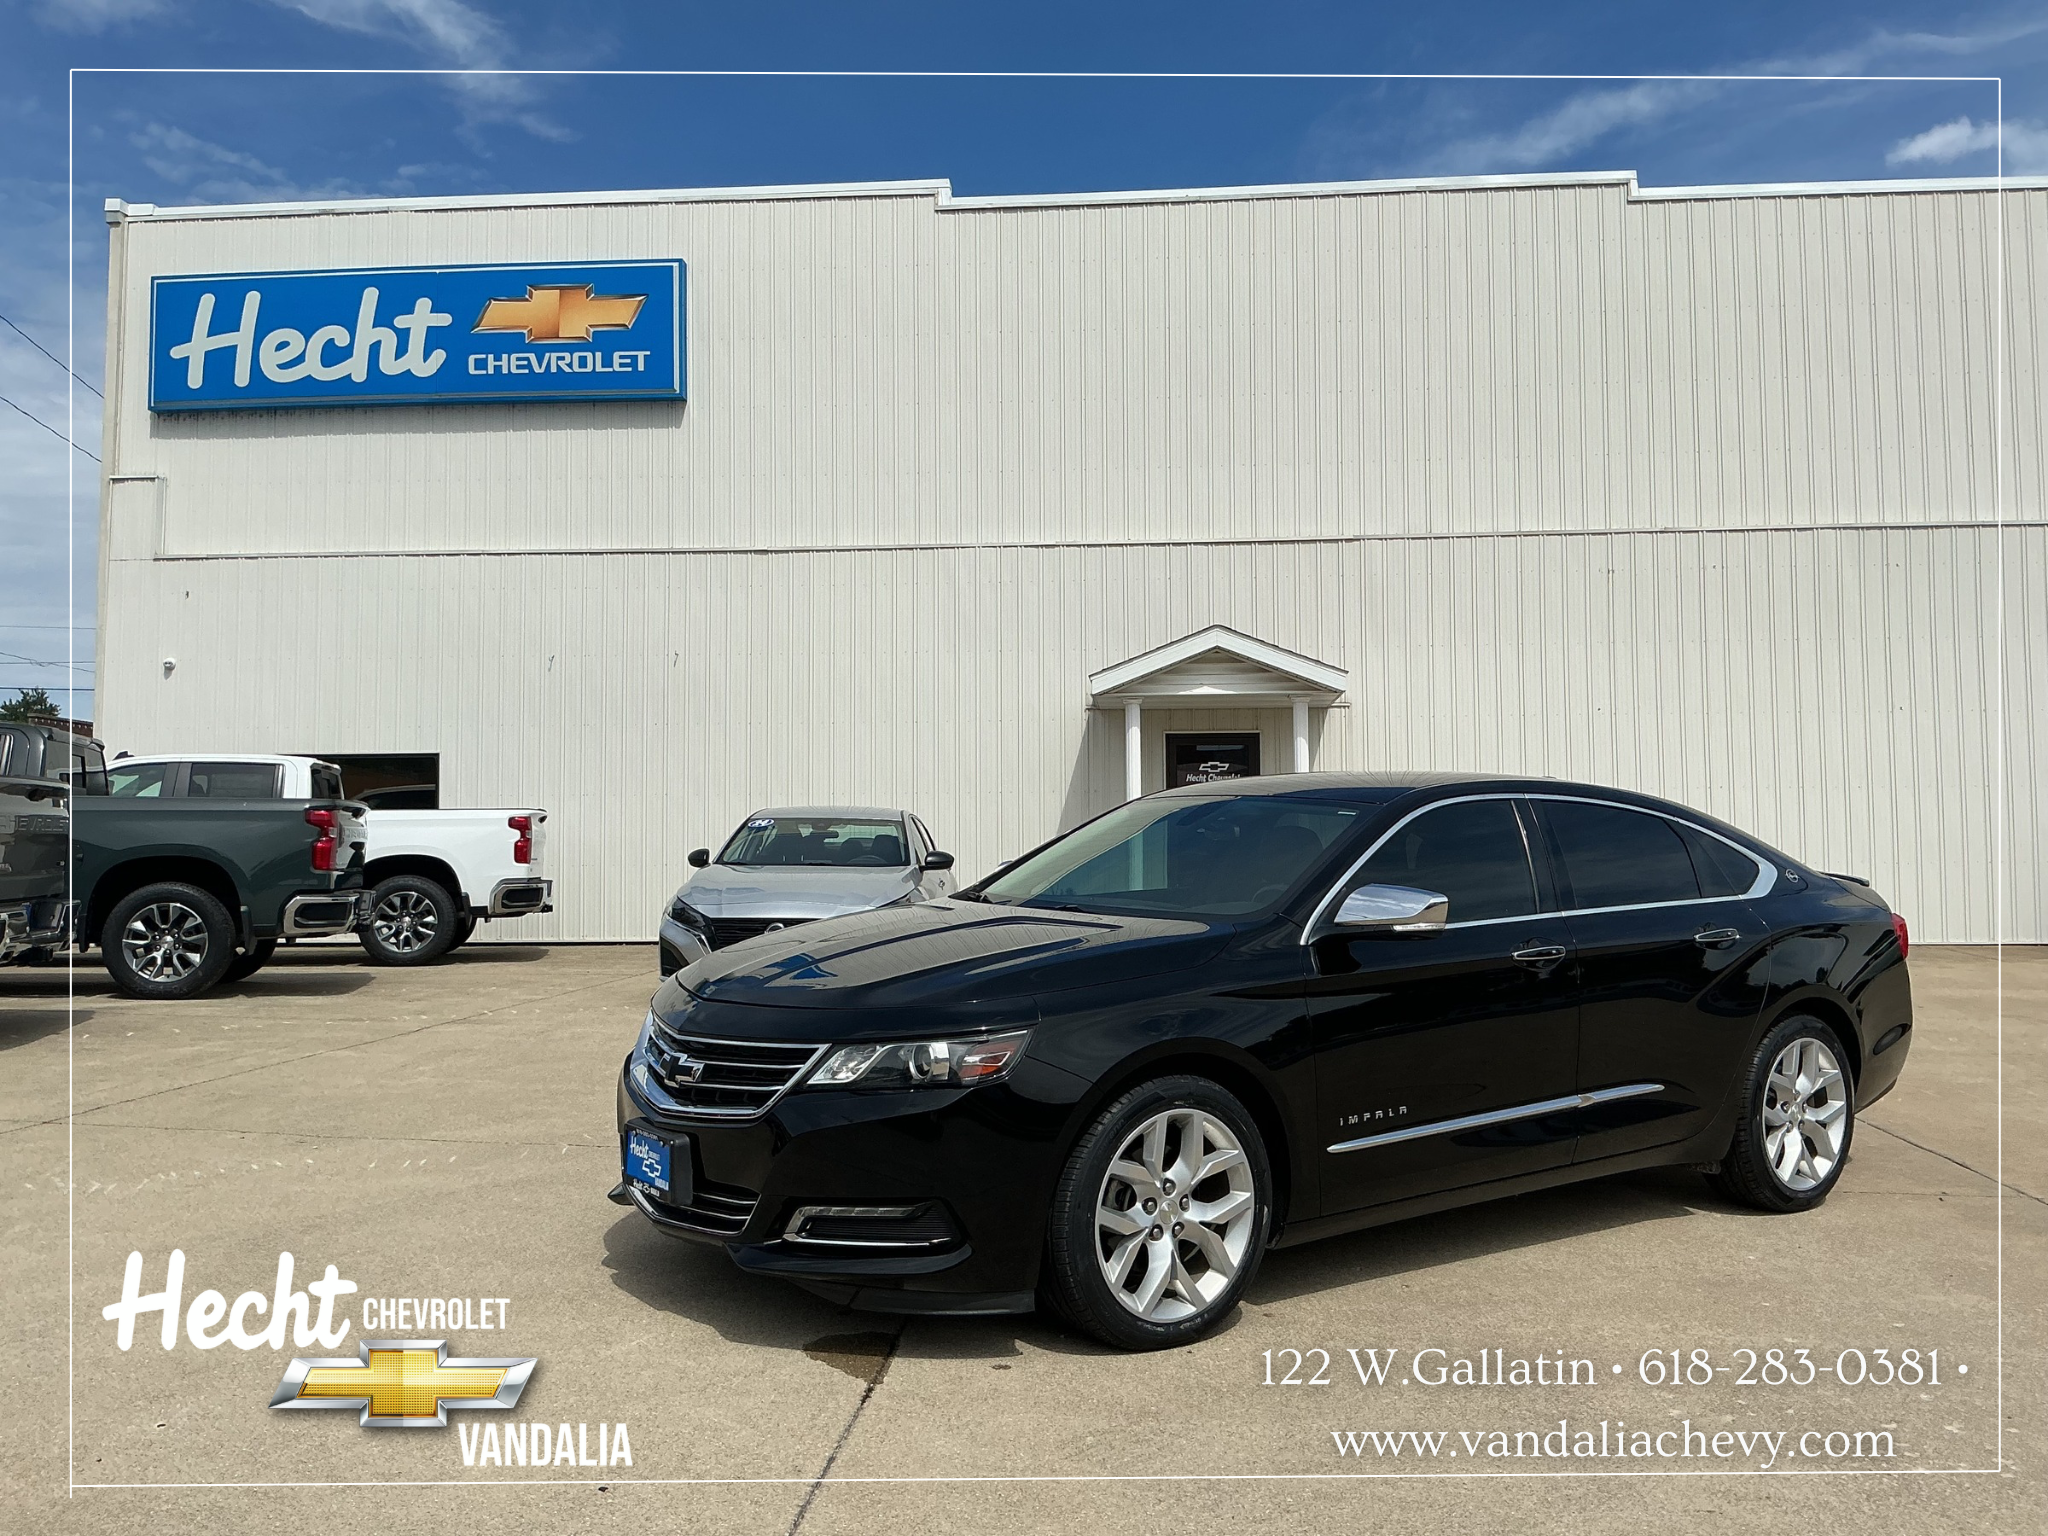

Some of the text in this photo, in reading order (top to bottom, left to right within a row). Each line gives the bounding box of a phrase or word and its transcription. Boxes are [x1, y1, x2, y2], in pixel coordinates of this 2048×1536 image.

[170, 286, 453, 389] Hecht
[468, 349, 651, 376] CHEVROLET
[1186, 773, 1207, 783] Hecht
[1339, 1105, 1408, 1127] IMPALA
